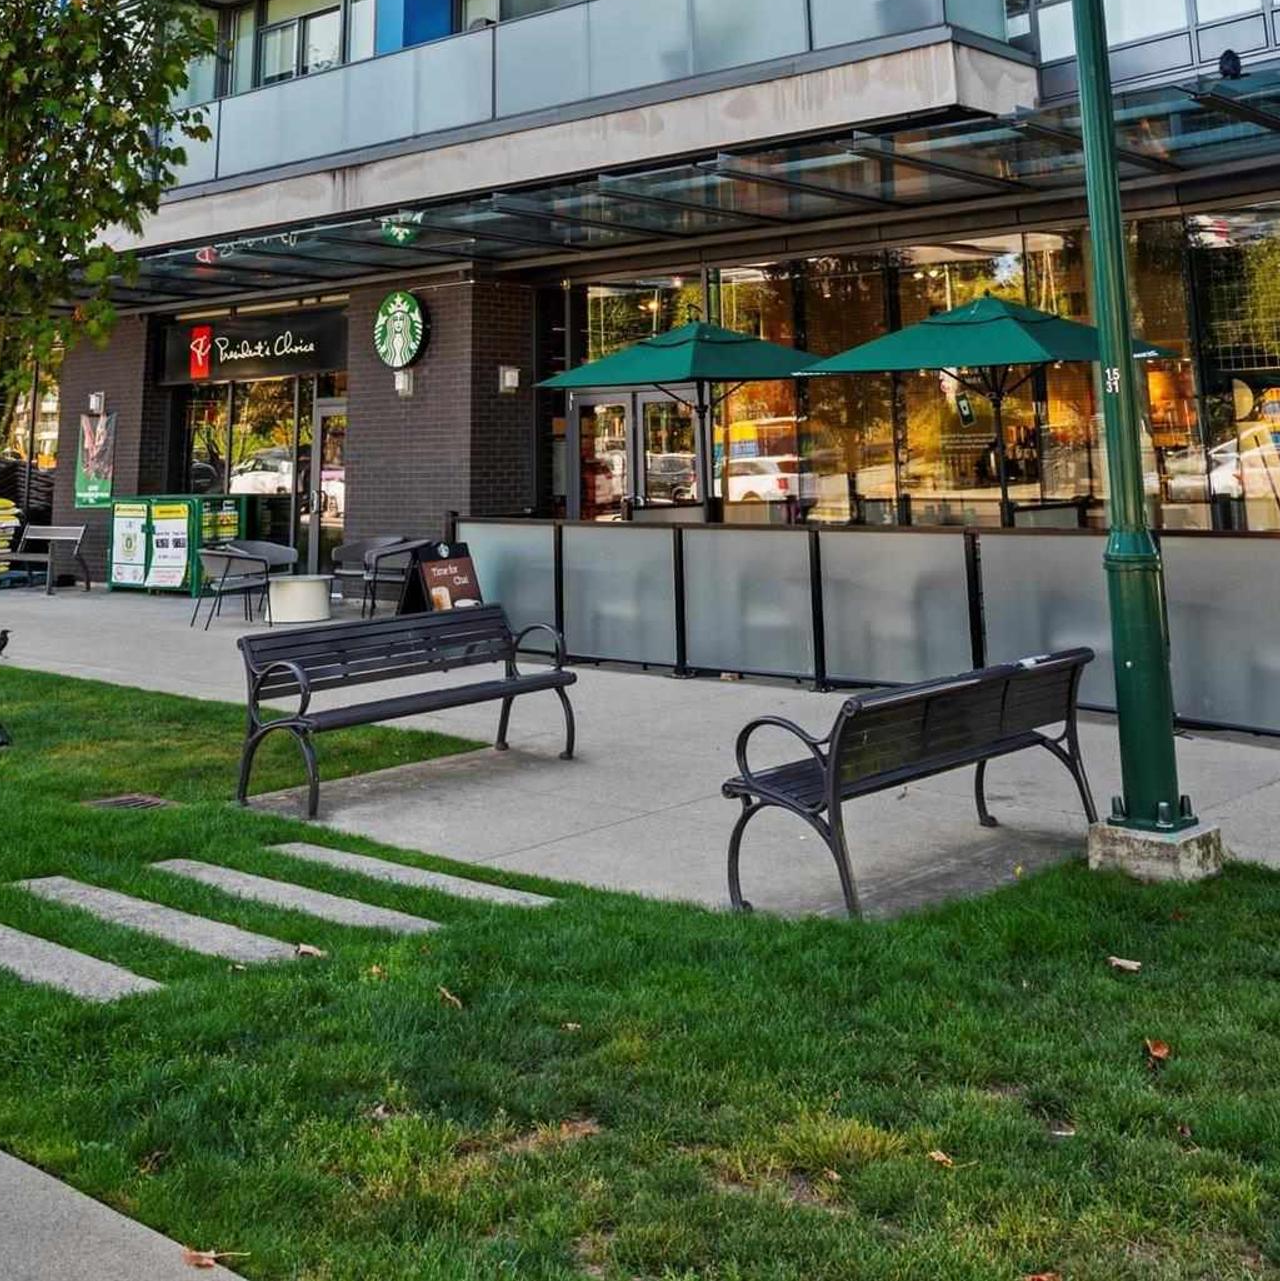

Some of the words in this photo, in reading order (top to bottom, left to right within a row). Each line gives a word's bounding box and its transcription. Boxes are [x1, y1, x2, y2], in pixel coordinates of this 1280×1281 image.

[215, 337, 271, 363] President's
[274, 330, 314, 356] Choice
[1105, 368, 1120, 381] 15
[1106, 380, 1119, 393] 31
